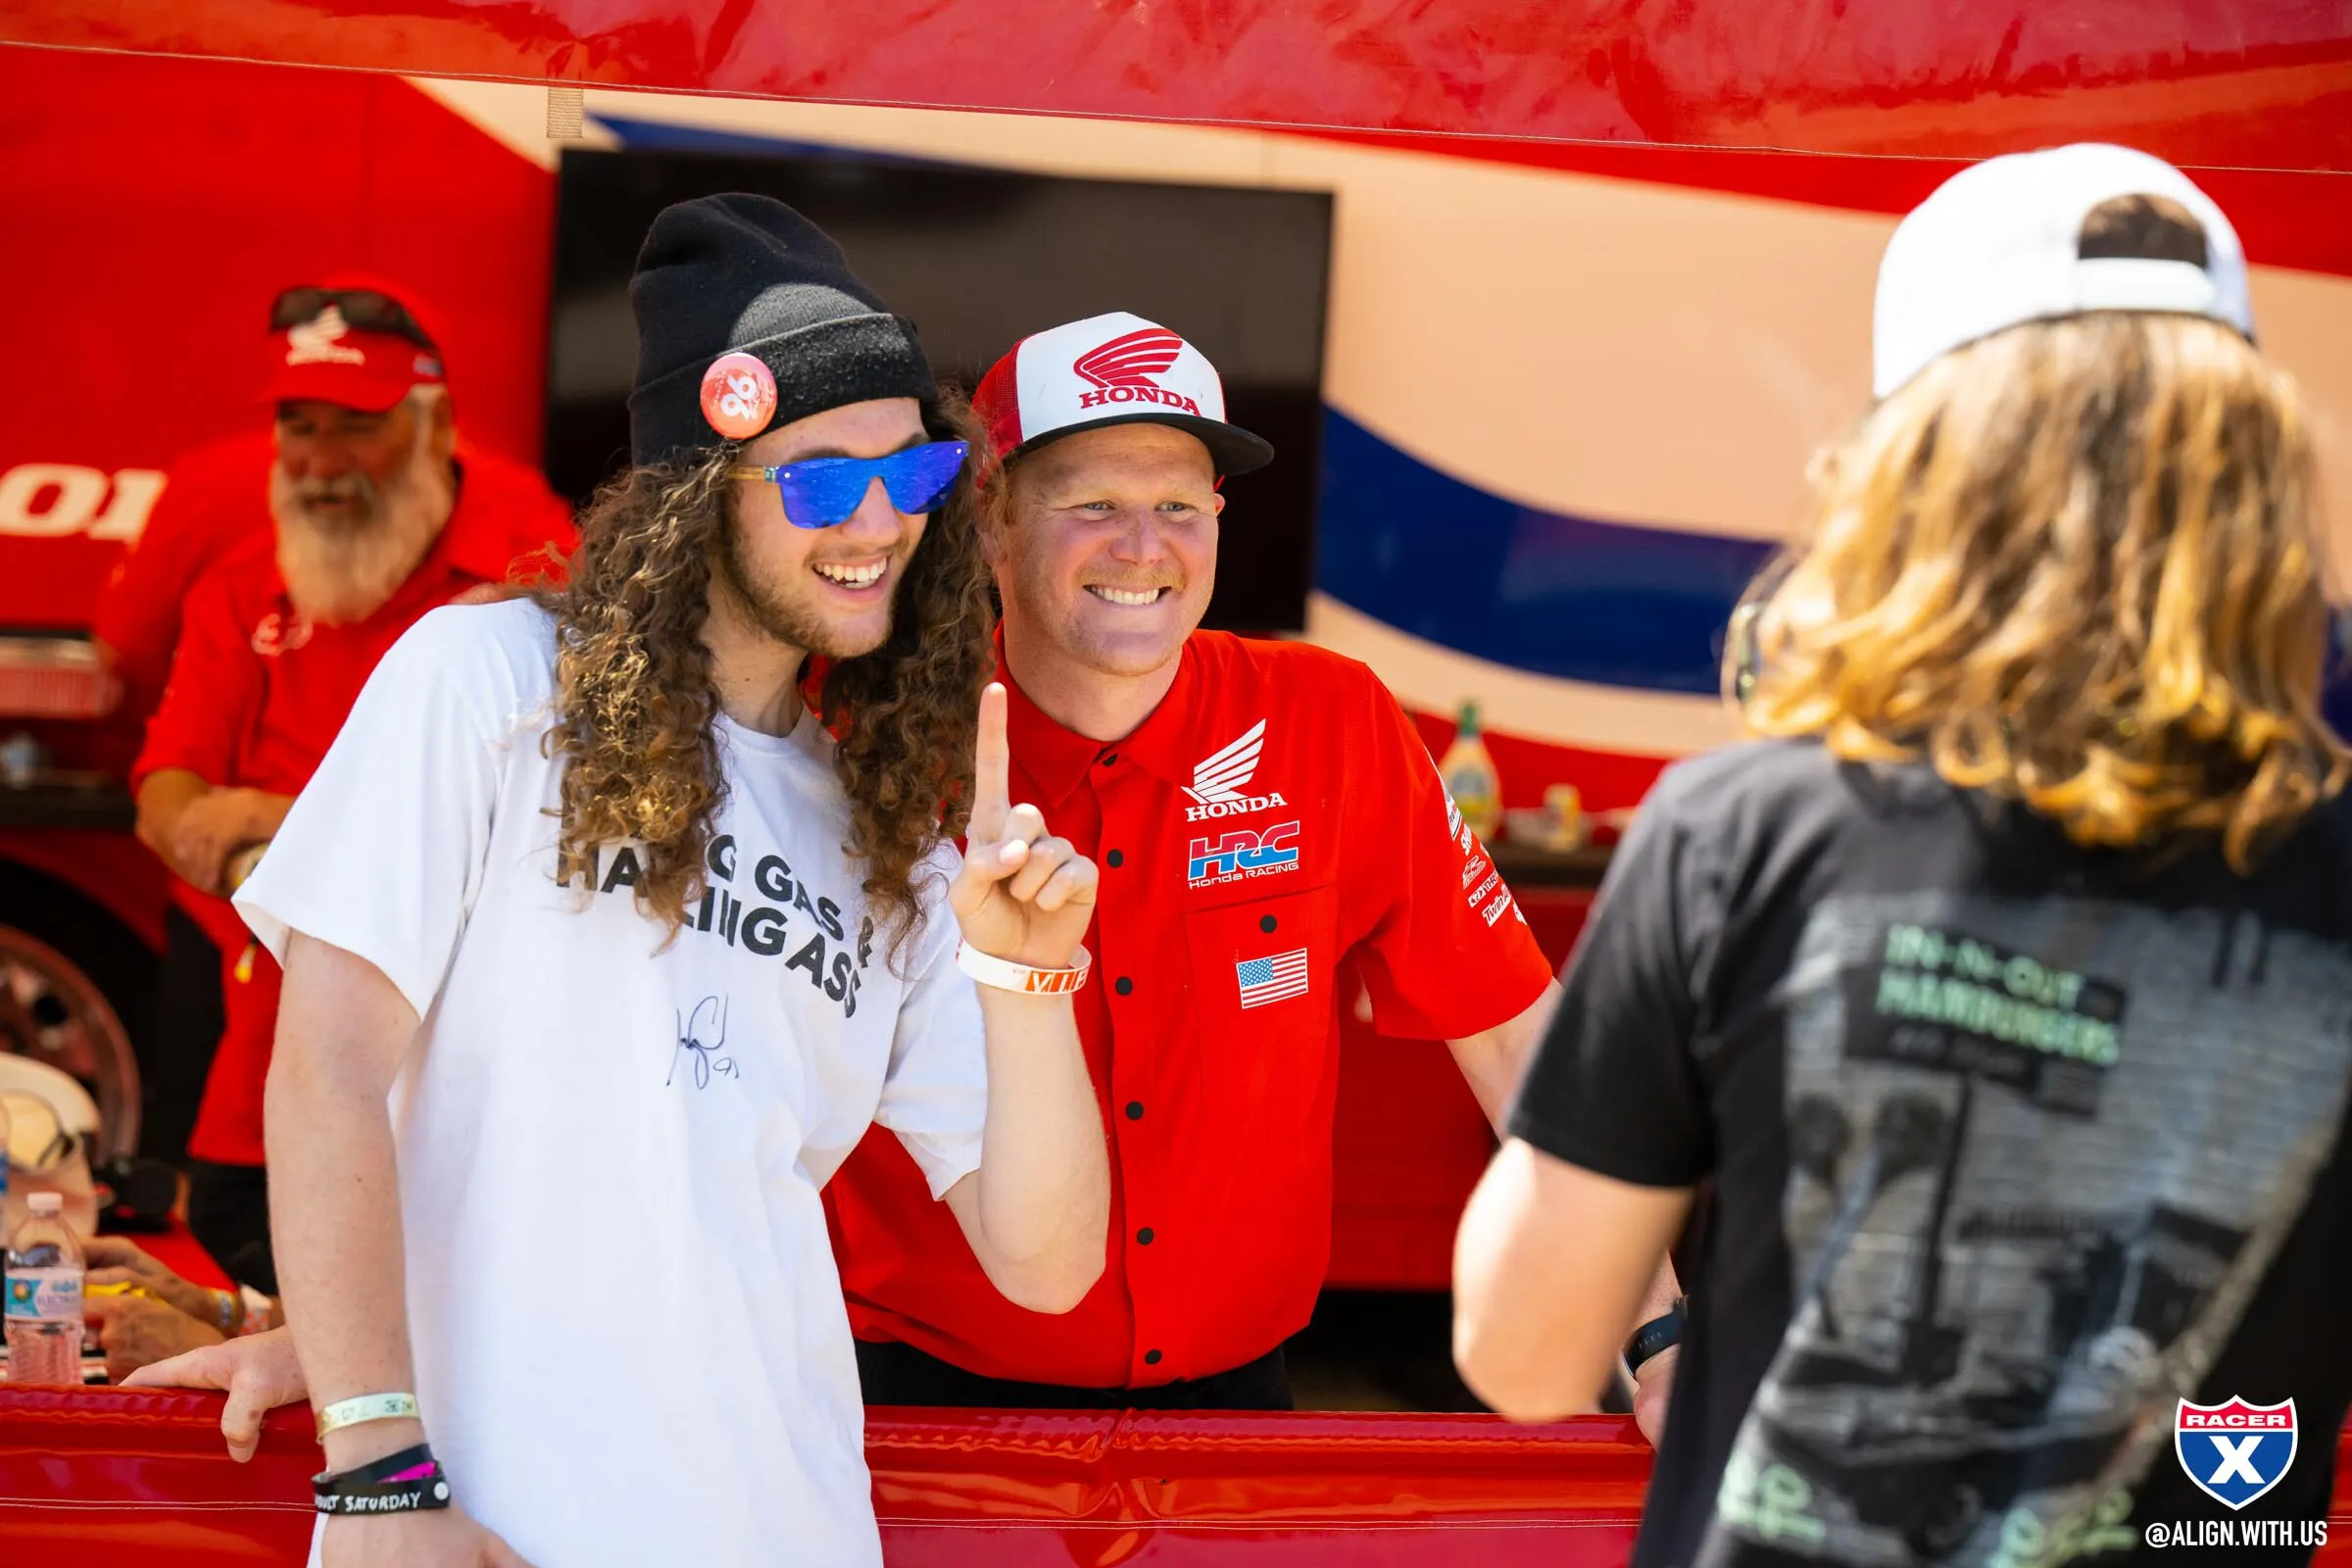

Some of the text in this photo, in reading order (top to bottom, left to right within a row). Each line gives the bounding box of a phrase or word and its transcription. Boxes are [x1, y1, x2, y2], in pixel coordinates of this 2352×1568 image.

[1079, 386, 1202, 418] HONDA
[1185, 792, 1288, 822] HONDA
[1188, 820, 1299, 881] HRC
[1189, 861, 1299, 889] Honda RACING
[755, 855, 845, 942] GAS
[557, 838, 861, 1018] HAING ASS
[345, 1492, 420, 1512] SATURDAY
